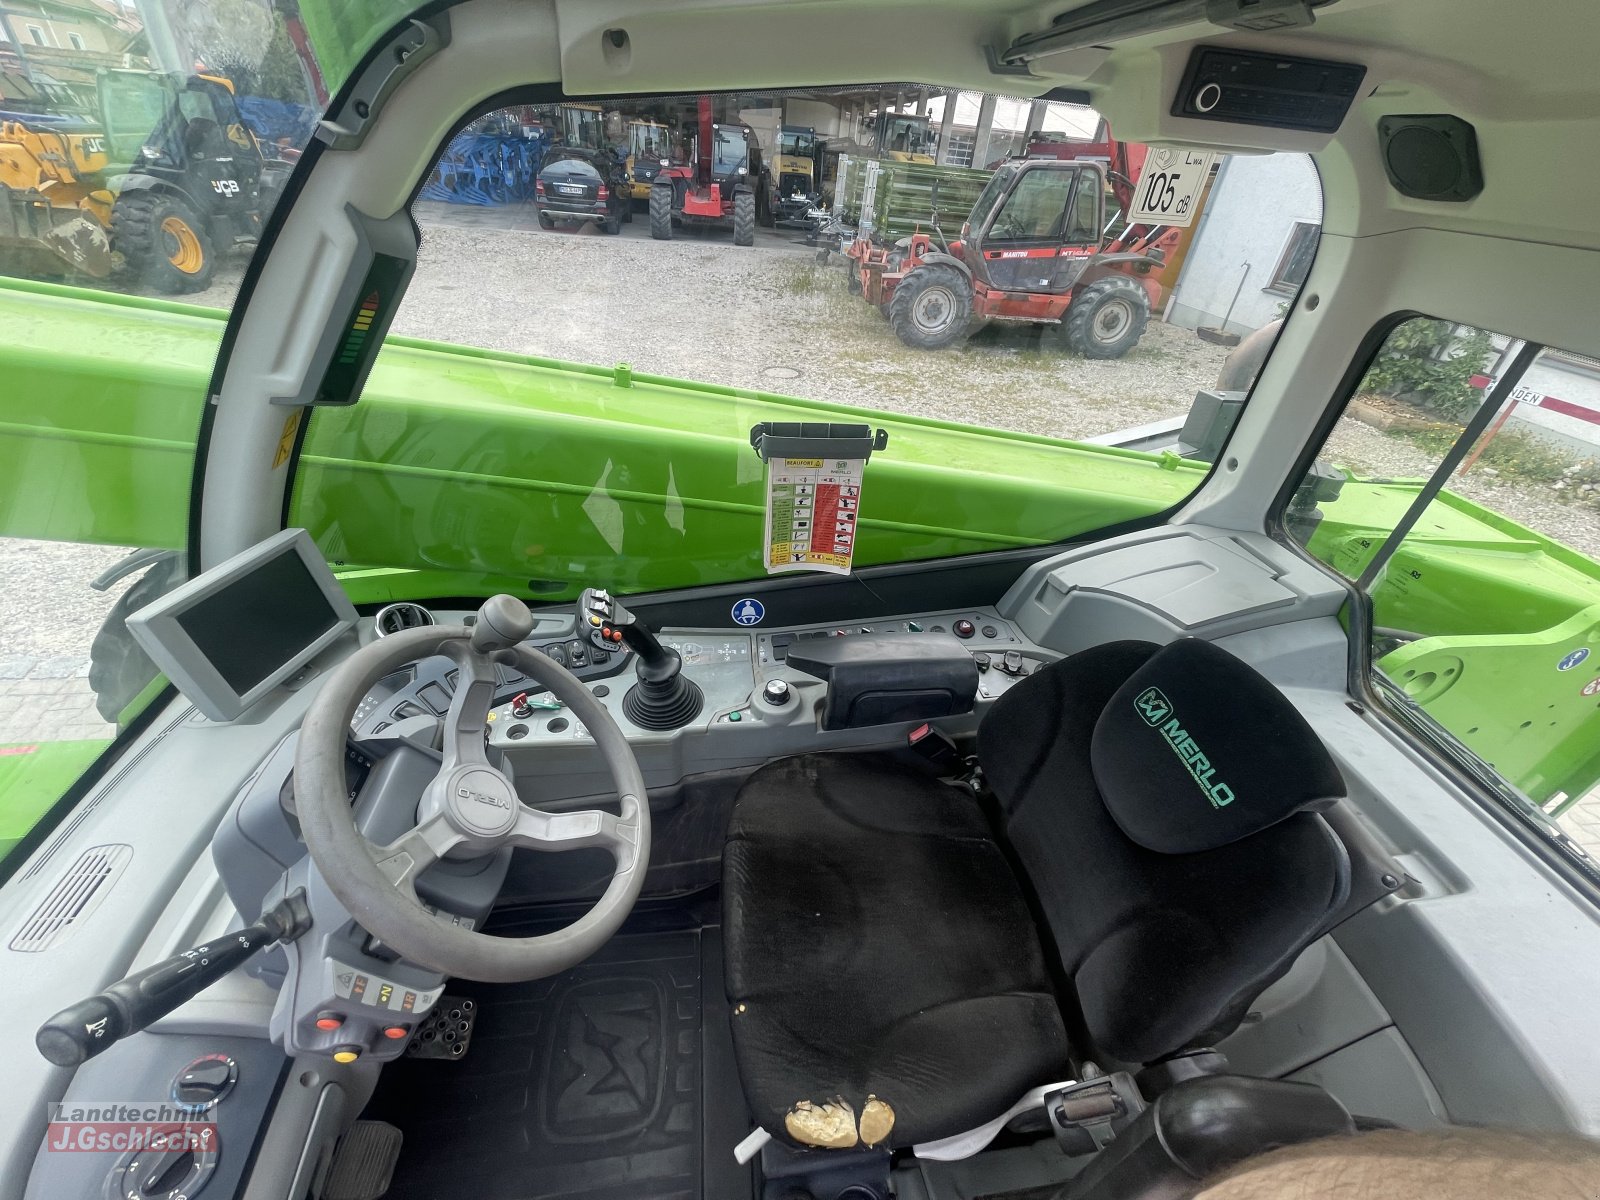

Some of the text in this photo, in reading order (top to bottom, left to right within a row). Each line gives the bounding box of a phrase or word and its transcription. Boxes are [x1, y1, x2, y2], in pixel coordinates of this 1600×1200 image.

[89, 138, 105, 152] JC
[212, 180, 240, 193] JCB
[1140, 171, 1191, 214] 105 dB
[1163, 718, 1235, 807] MERLO
[457, 787, 511, 811] MERLO
[380, 985, 393, 997] N
